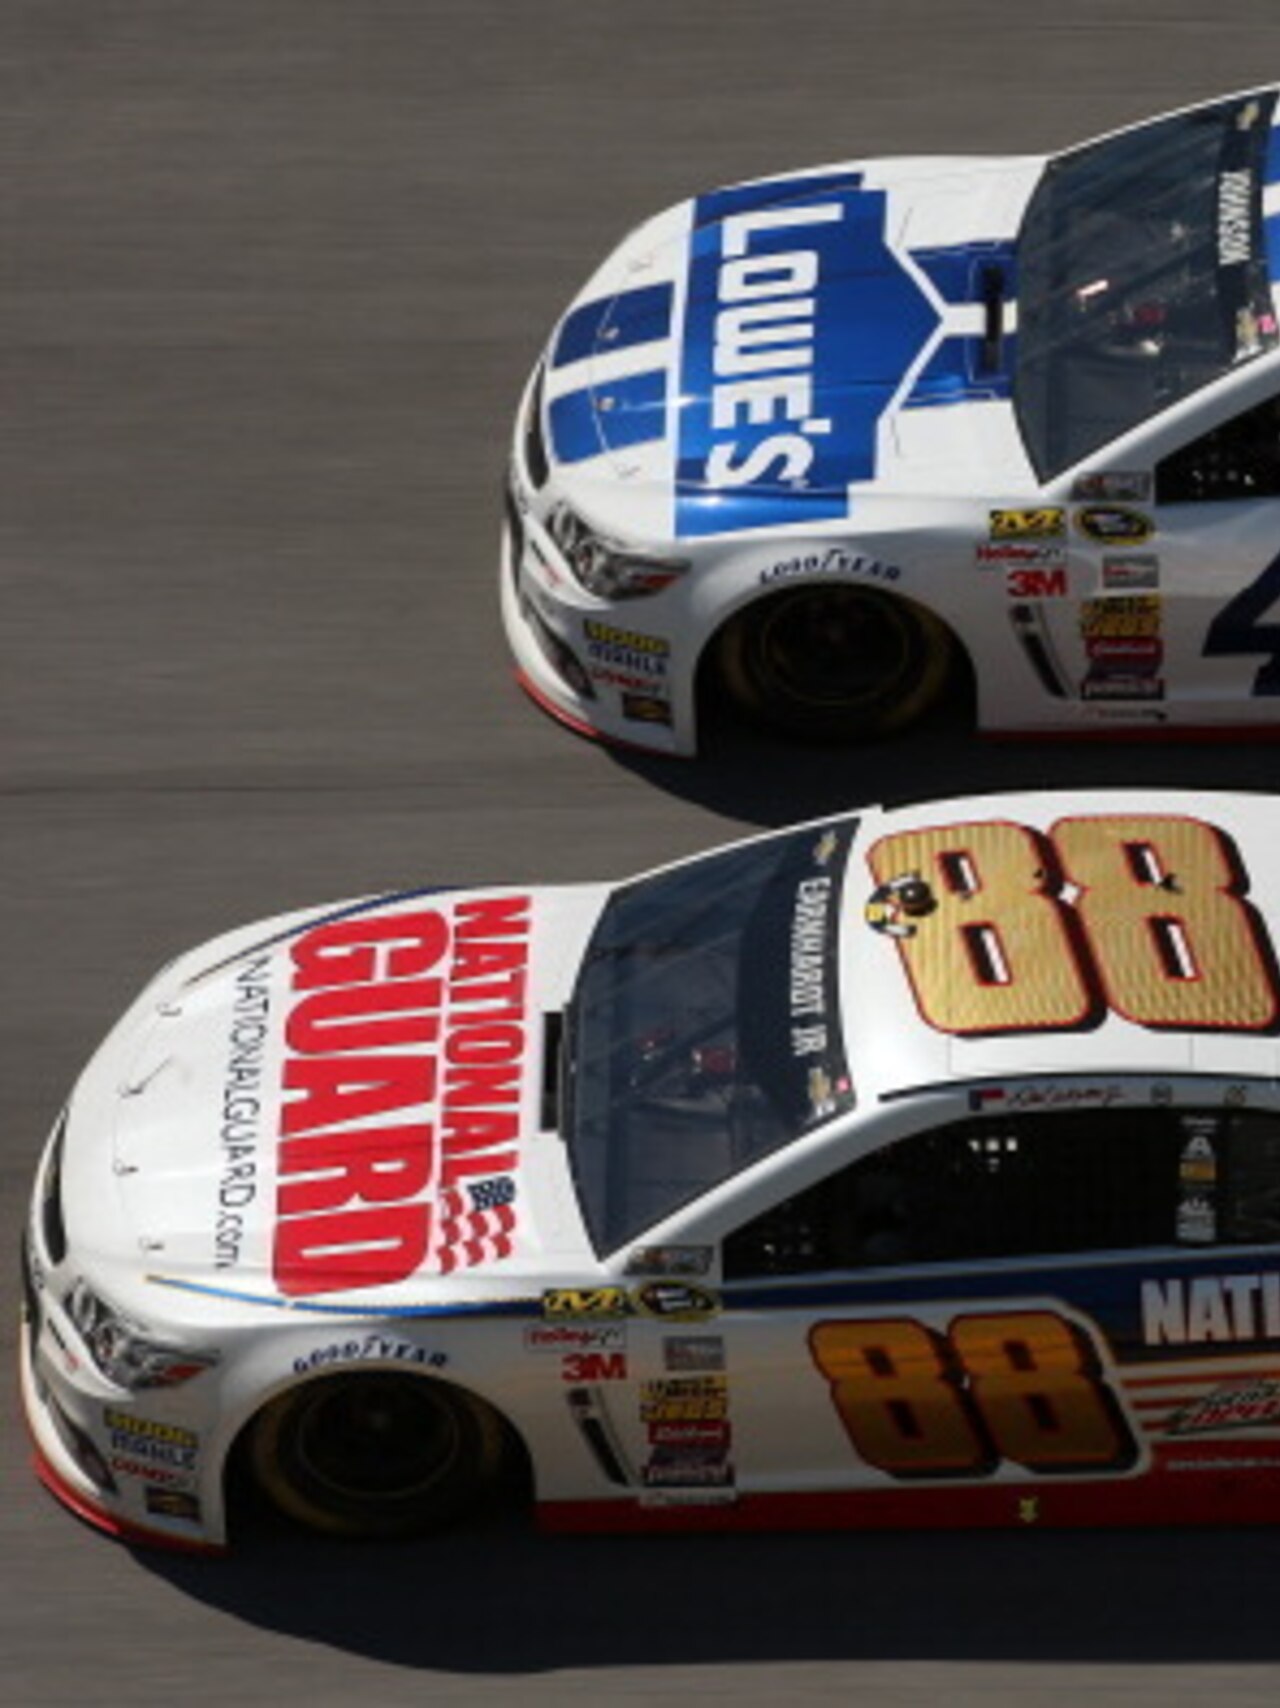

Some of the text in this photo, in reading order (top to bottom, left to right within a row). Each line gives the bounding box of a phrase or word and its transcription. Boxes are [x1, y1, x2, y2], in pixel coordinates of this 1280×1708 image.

[704, 203, 844, 491] LOWE'S
[1007, 567, 1067, 598] 3M
[440, 896, 531, 1189] NATIONAL
[790, 876, 831, 1056] EARNHARDT JR
[271, 907, 450, 1298] GUARD
[292, 1334, 448, 1373] GOODYEAR
[562, 1353, 627, 1383] 3M
[807, 1310, 1144, 1478] 88
